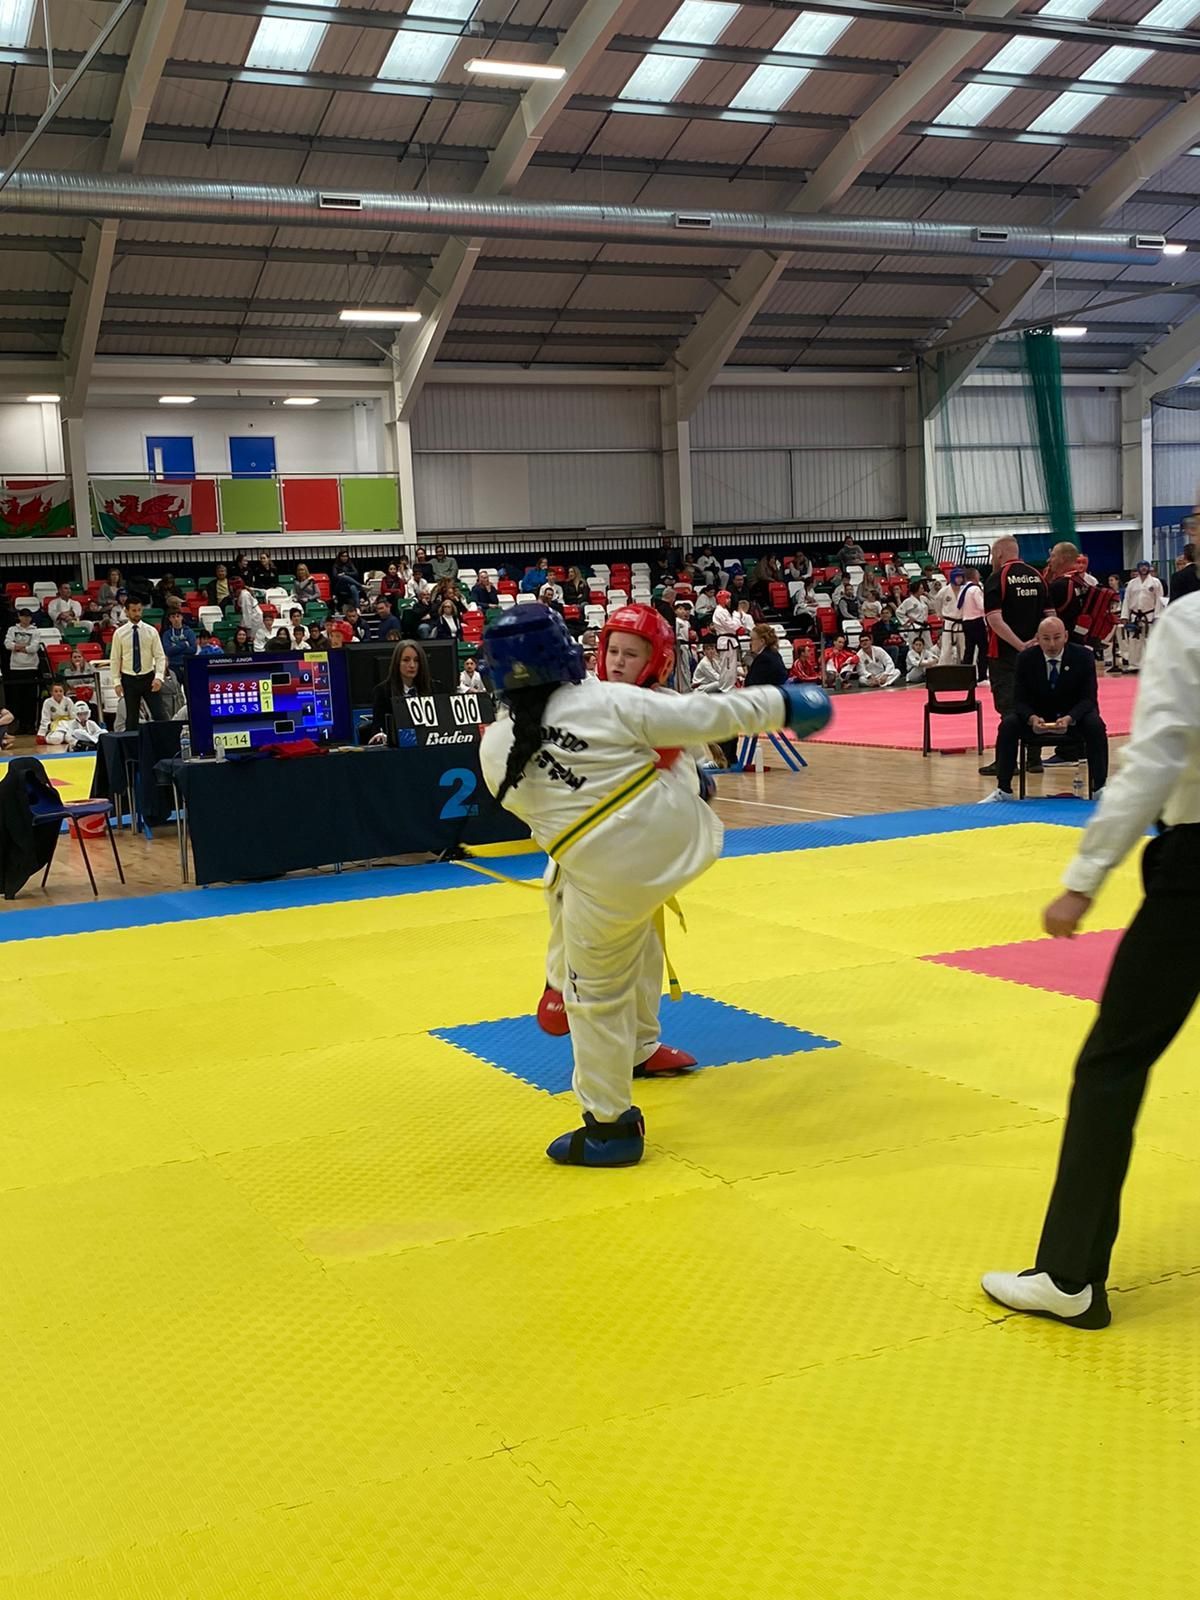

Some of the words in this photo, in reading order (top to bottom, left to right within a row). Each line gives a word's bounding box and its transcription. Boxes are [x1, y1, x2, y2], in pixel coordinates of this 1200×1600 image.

[1016, 587, 1038, 597] Team
[303, 673, 310, 682] 0
[213, 684, 221, 692] -2
[225, 683, 233, 691] -2
[238, 682, 245, 690] -2
[250, 682, 257, 690] -2
[262, 681, 269, 691] 0
[215, 706, 222, 714] -1
[228, 705, 234, 713] 0
[240, 704, 247, 713] -3
[251, 704, 259, 712] -3
[264, 700, 270, 710] 1
[322, 728, 329, 740] 1
[214, 734, 248, 747] 01:14
[438, 767, 477, 820] 2
